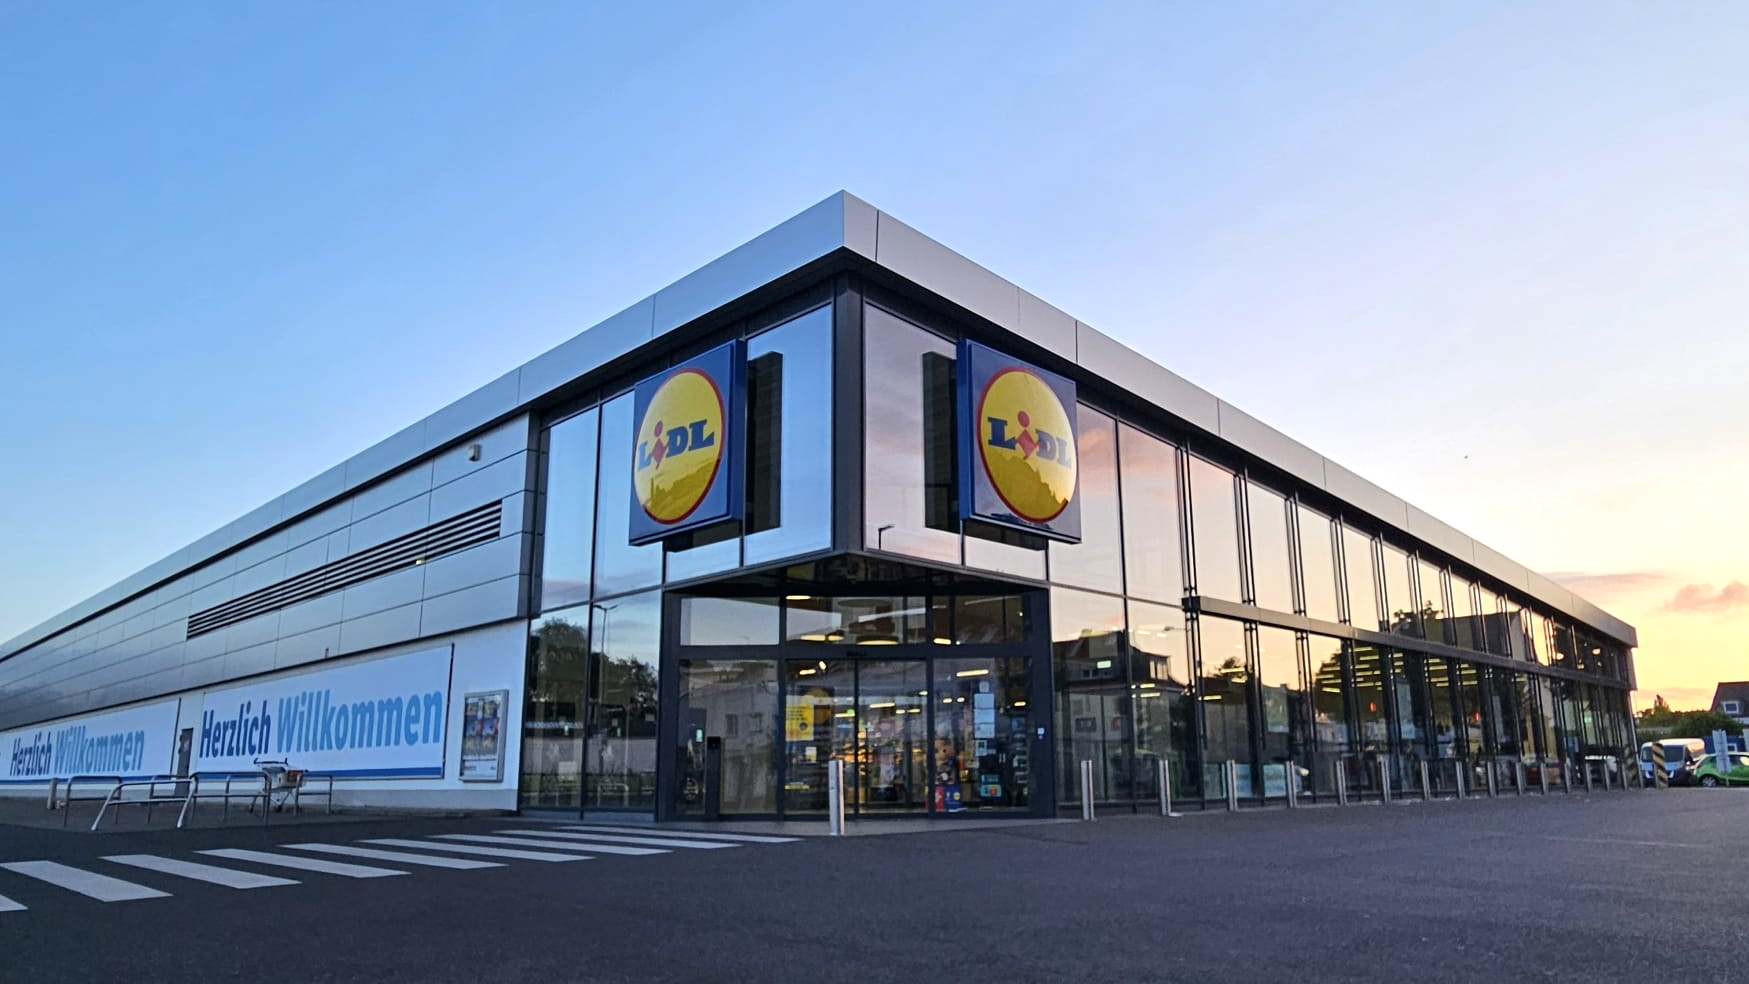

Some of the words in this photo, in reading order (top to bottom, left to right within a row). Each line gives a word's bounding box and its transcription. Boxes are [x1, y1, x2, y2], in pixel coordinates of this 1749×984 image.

[9, 730, 52, 776] Herzlich
[54, 724, 145, 774] Willkommen
[199, 700, 271, 758] Herzlich
[277, 689, 443, 753] Willkommen
